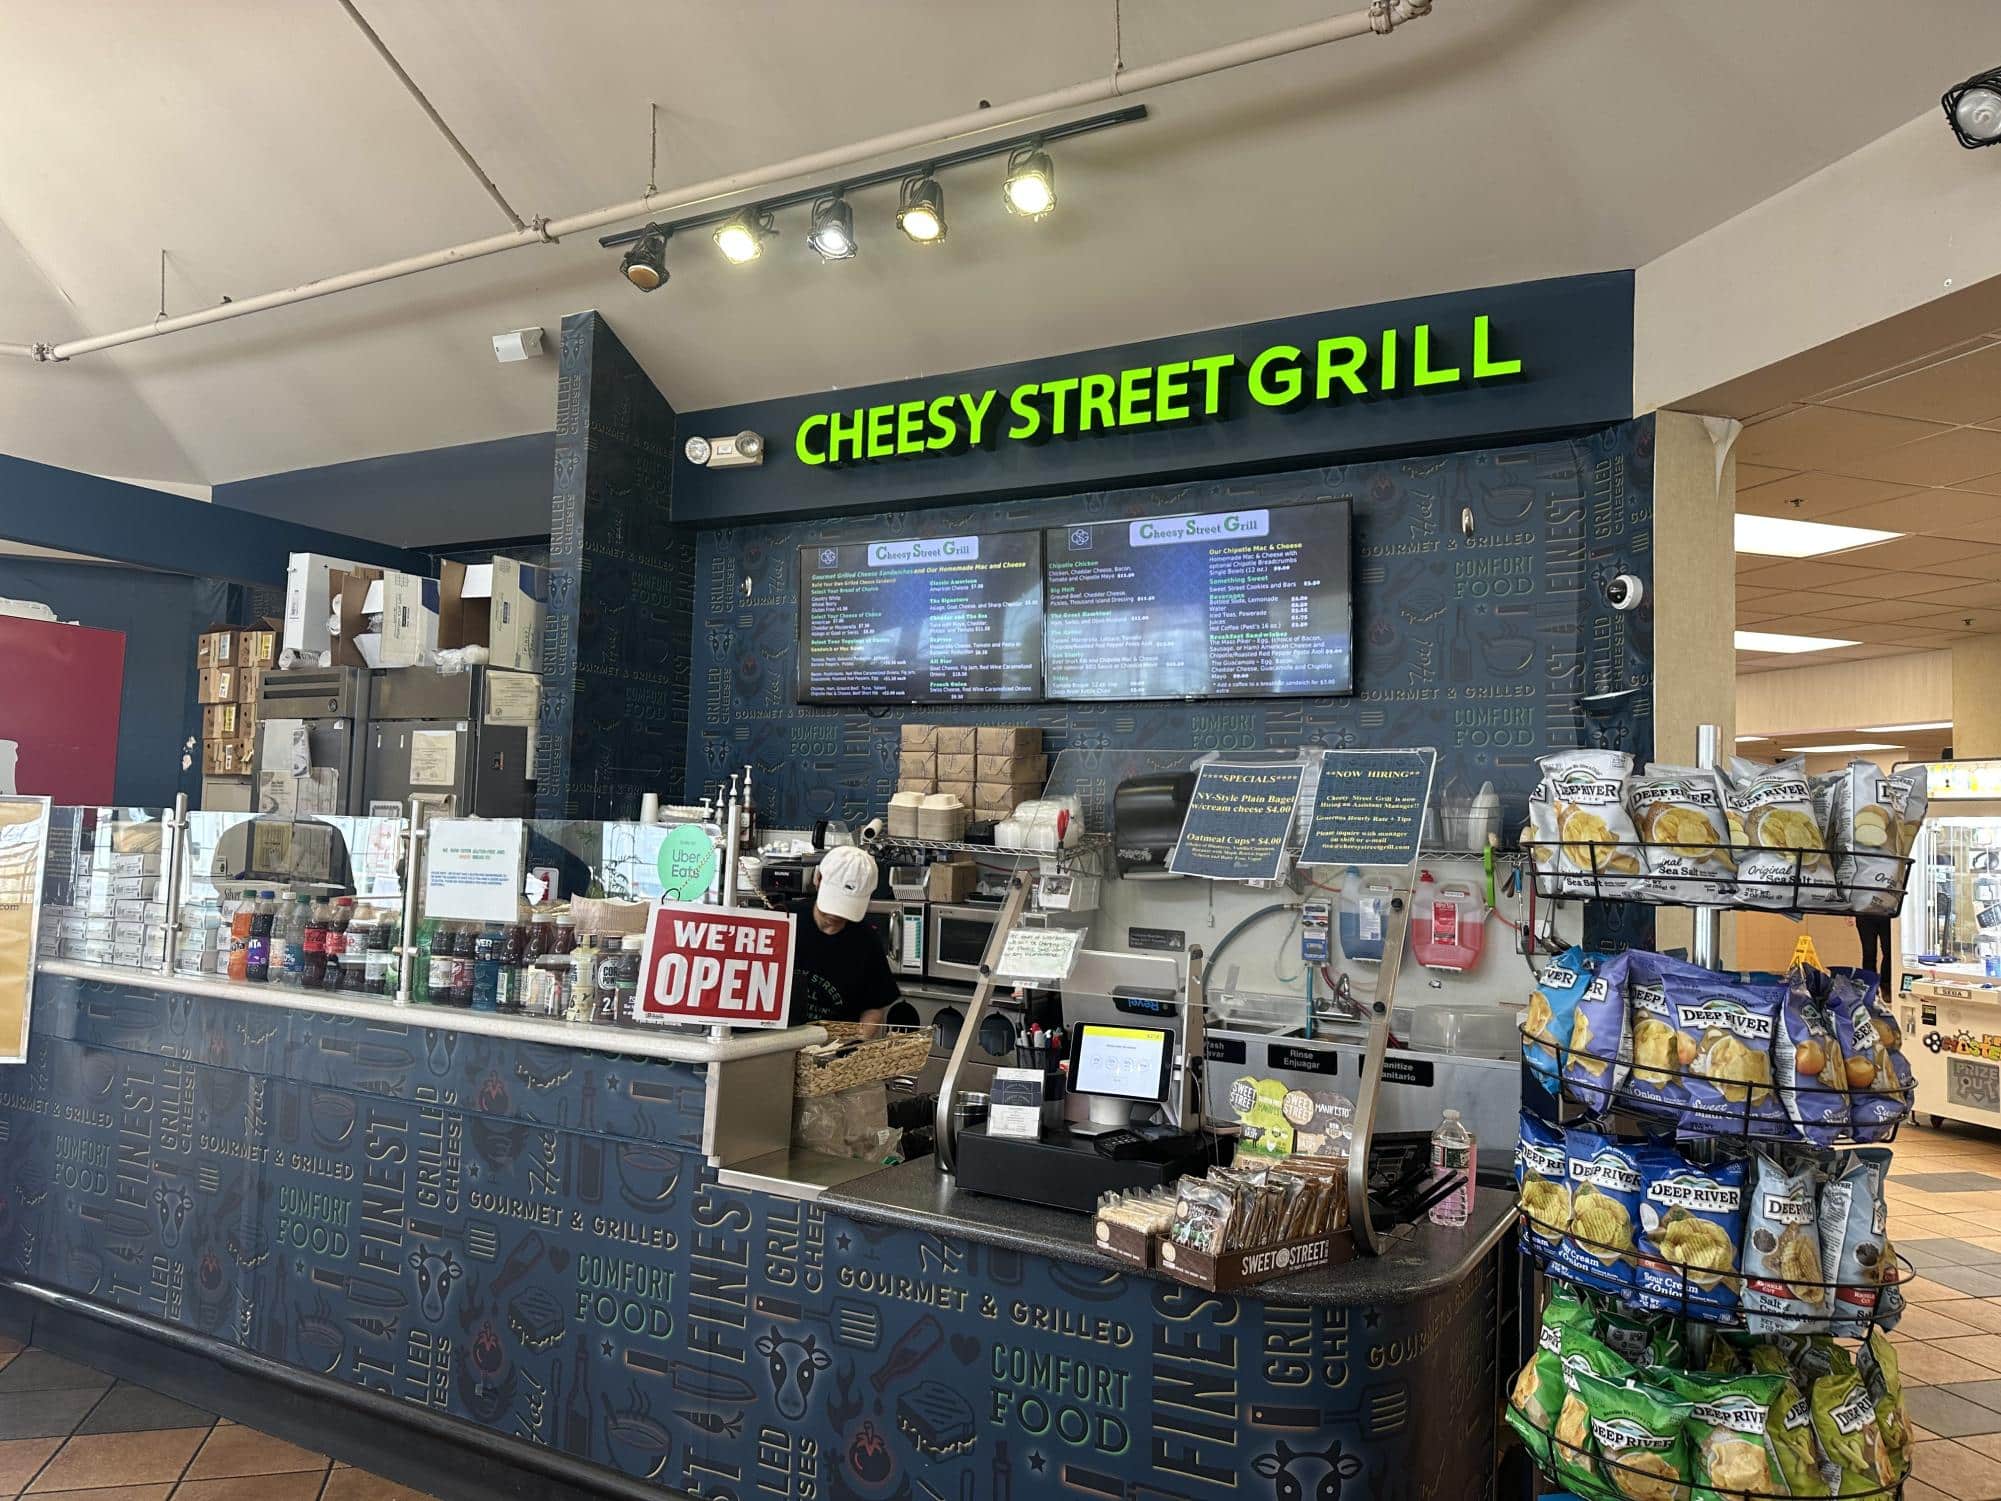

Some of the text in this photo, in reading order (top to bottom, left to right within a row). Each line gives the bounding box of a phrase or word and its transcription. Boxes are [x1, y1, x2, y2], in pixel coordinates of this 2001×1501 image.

[795, 315, 1522, 466] CHEESY STREET GRILL
[1593, 459, 1612, 539] GRILLED
[1613, 455, 1624, 535] CHEESES
[1140, 515, 1257, 539] Cheesy Street Grill
[913, 543, 941, 558] Street
[943, 541, 969, 556] Grill
[1277, 542, 1303, 550] Cheese
[1361, 539, 1441, 557] GOURMET
[1466, 532, 1536, 549] GRILLED
[1546, 492, 1587, 594] FINEST
[1455, 555, 1535, 578] COMFORT
[711, 557, 726, 614] GRILLED
[727, 556, 736, 613] CHEESES
[1454, 578, 1535, 600] FOOD
[706, 667, 722, 726] GRILLED
[721, 667, 736, 726] CHEESES
[1360, 685, 1441, 702] GOURMET
[1466, 684, 1536, 699] GRILLED
[1191, 713, 1256, 733] COMFORT
[1455, 707, 1534, 728] COMFORT
[790, 726, 838, 741] COMFORT
[1192, 734, 1256, 751] FOOD
[1454, 729, 1535, 749] FOOD
[789, 742, 839, 757] FOOD
[1197, 792, 1297, 805] NY-Style Plain Bagel
[1633, 788, 1669, 805] DEEP
[1763, 783, 1809, 798] RIVER
[1190, 802, 1231, 812] w/cream
[1233, 804, 1264, 813] cheese
[1186, 832, 1225, 844] Oatmeal
[672, 849, 701, 863] Uber
[672, 864, 700, 879] Eats
[1659, 865, 1679, 876] Sea
[1748, 864, 1793, 880] Original
[1567, 878, 1583, 887] Sea
[673, 919, 775, 955] WE'RE
[654, 953, 779, 1012] OPEN
[811, 974, 843, 1006] STREET
[1684, 1010, 1770, 1033] DEEP RIVER
[1283, 1058, 1321, 1070] Enjuagar
[1290, 1049, 1314, 1060] Rinse
[1380, 1071, 1416, 1082] anitario
[1382, 1062, 1414, 1072] anitize
[1958, 1062, 2000, 1080] PRIZE
[160, 1042, 183, 1151] GRILLED
[181, 1045, 198, 1154] CHEESES
[1230, 1092, 1256, 1109] STREET
[1232, 1081, 1257, 1099] SWEET
[1634, 1089, 1662, 1102] Onion
[1283, 1104, 1312, 1121] STREET
[1286, 1095, 1314, 1112] SWEET
[1692, 1099, 1728, 1111] Sweet
[64, 1106, 114, 1129] GRILLED
[114, 1065, 156, 1209] FINEST
[415, 1086, 446, 1208] GRILLED
[55, 1135, 112, 1168] COMFORT
[199, 1132, 355, 1182] GOURMET & GRILLED
[445, 1088, 463, 1214] CHEESES
[52, 1164, 109, 1196] FOOD
[1572, 1164, 1601, 1178] DEEP
[359, 1108, 409, 1275] FINEST
[1651, 1184, 1739, 1205] DEEP RIVER
[277, 1183, 353, 1226] COMFORT
[470, 1190, 679, 1250] GOURMET & GRILLED
[276, 1218, 351, 1260] FOOD
[687, 1165, 753, 1364] FINEST
[1242, 1253, 1276, 1276] SWEET
[1288, 1240, 1325, 1265] STREET
[1563, 1254, 1590, 1272] Onion
[1571, 1249, 1600, 1267] Cream
[575, 1253, 675, 1304] COMFORT
[1666, 1277, 1698, 1294] Crem
[837, 1264, 1135, 1348] GOURMET & GRILLED
[1759, 1295, 1781, 1309] Salt
[575, 1288, 674, 1340] FOOD
[991, 1340, 1130, 1409] COMFORT
[1151, 1286, 1241, 1488] FINES
[990, 1384, 1130, 1456] FOOD
[1697, 1406, 1768, 1425] DEEP RIVE
[1626, 1435, 1673, 1450] RIVER
